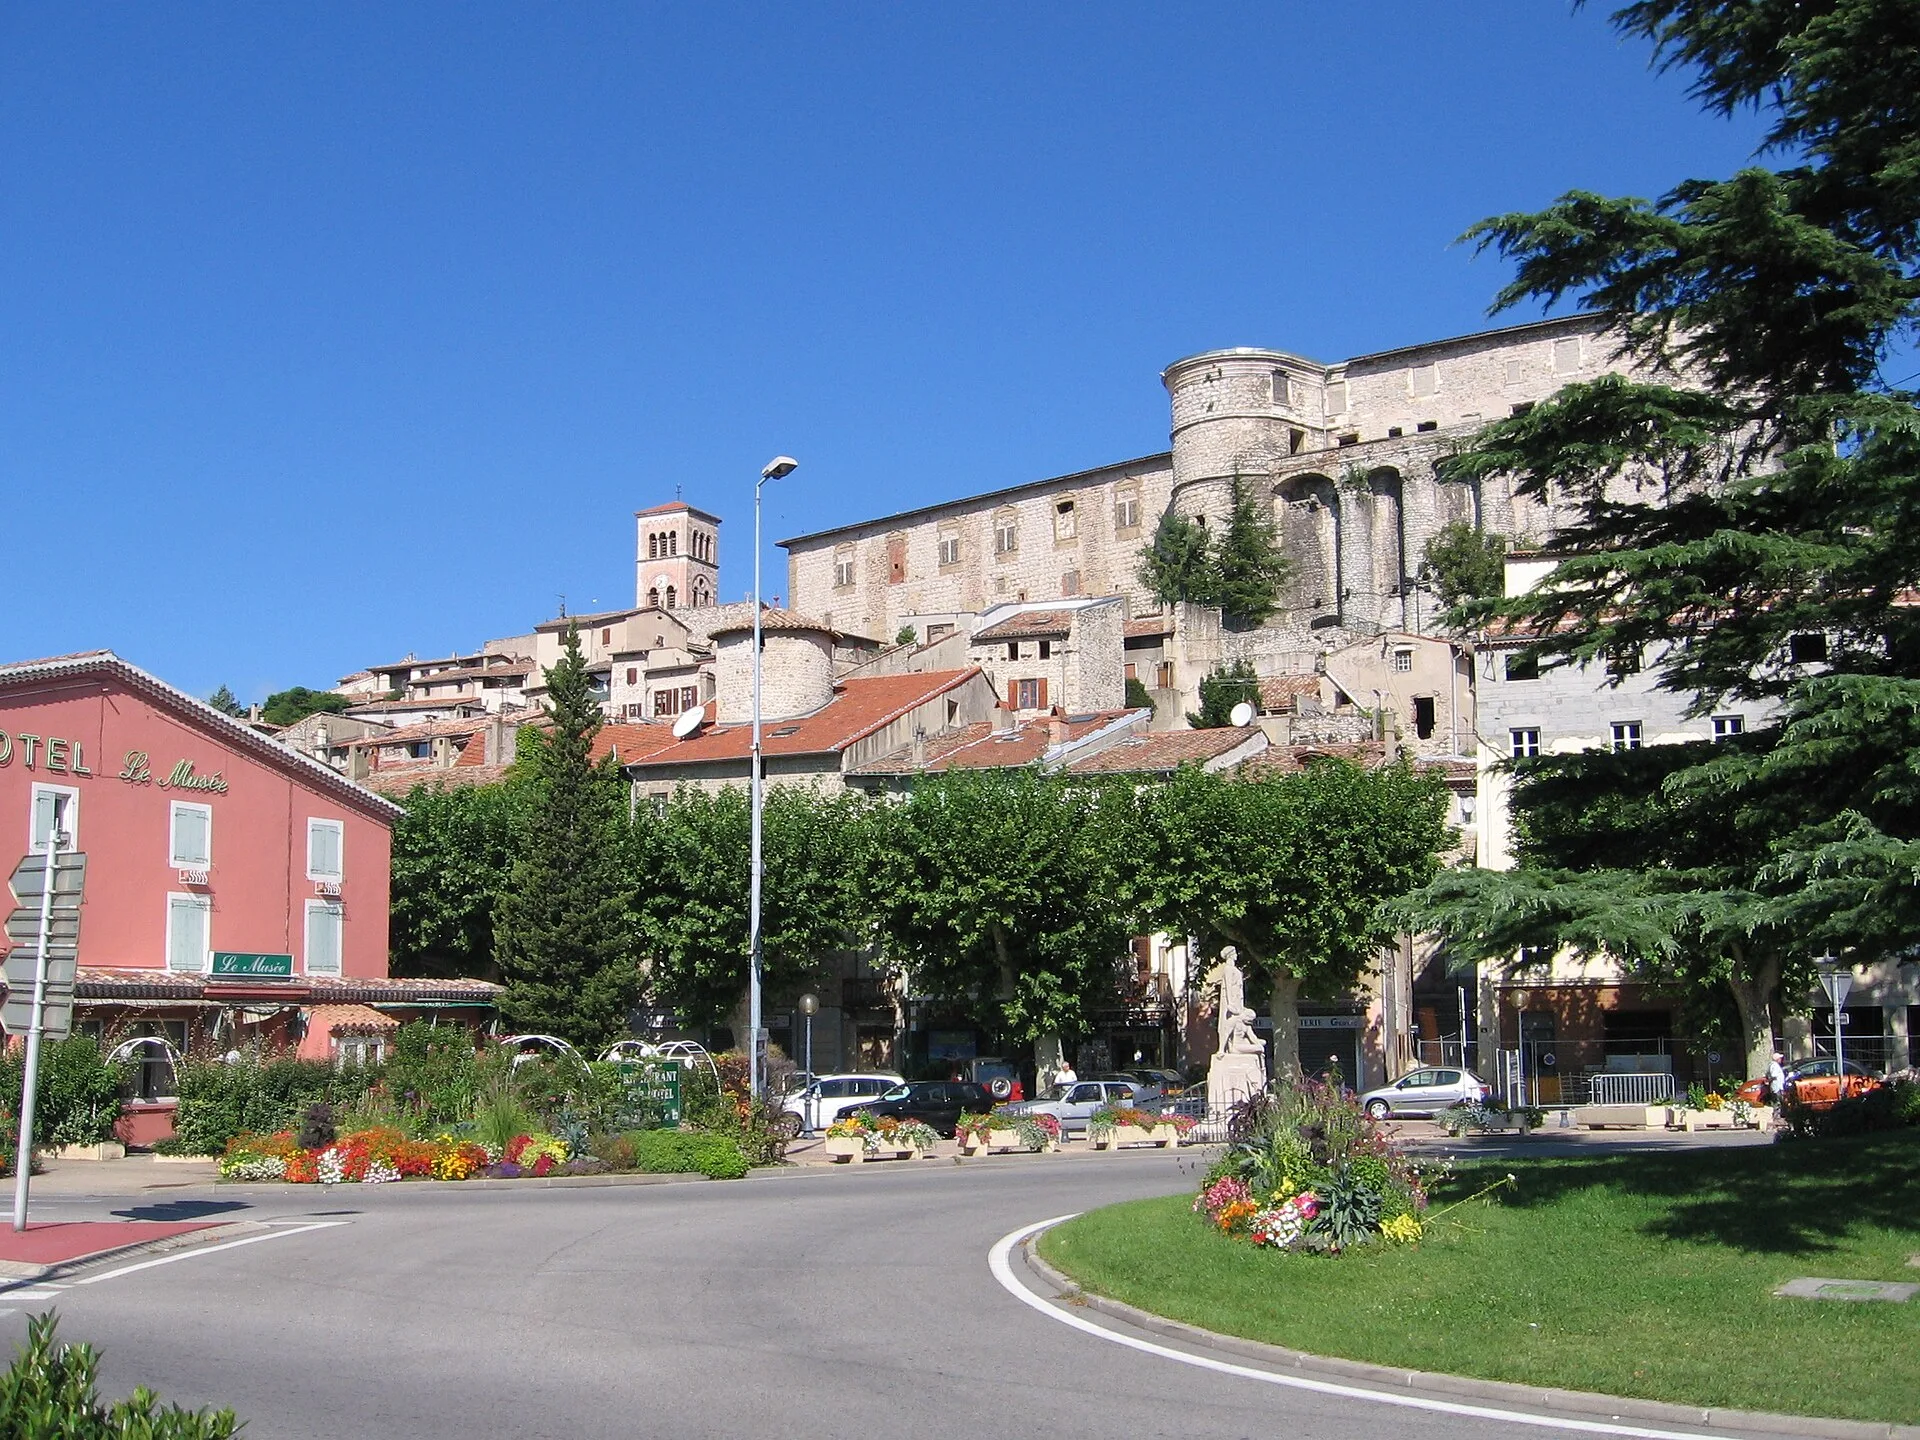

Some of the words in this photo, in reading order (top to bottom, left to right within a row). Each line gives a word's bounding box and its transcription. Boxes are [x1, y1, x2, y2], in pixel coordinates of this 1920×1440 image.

[119, 750, 150, 781] Le
[156, 758, 229, 793] Musée
[219, 955, 239, 972] Le
[242, 955, 286, 973] Musée
